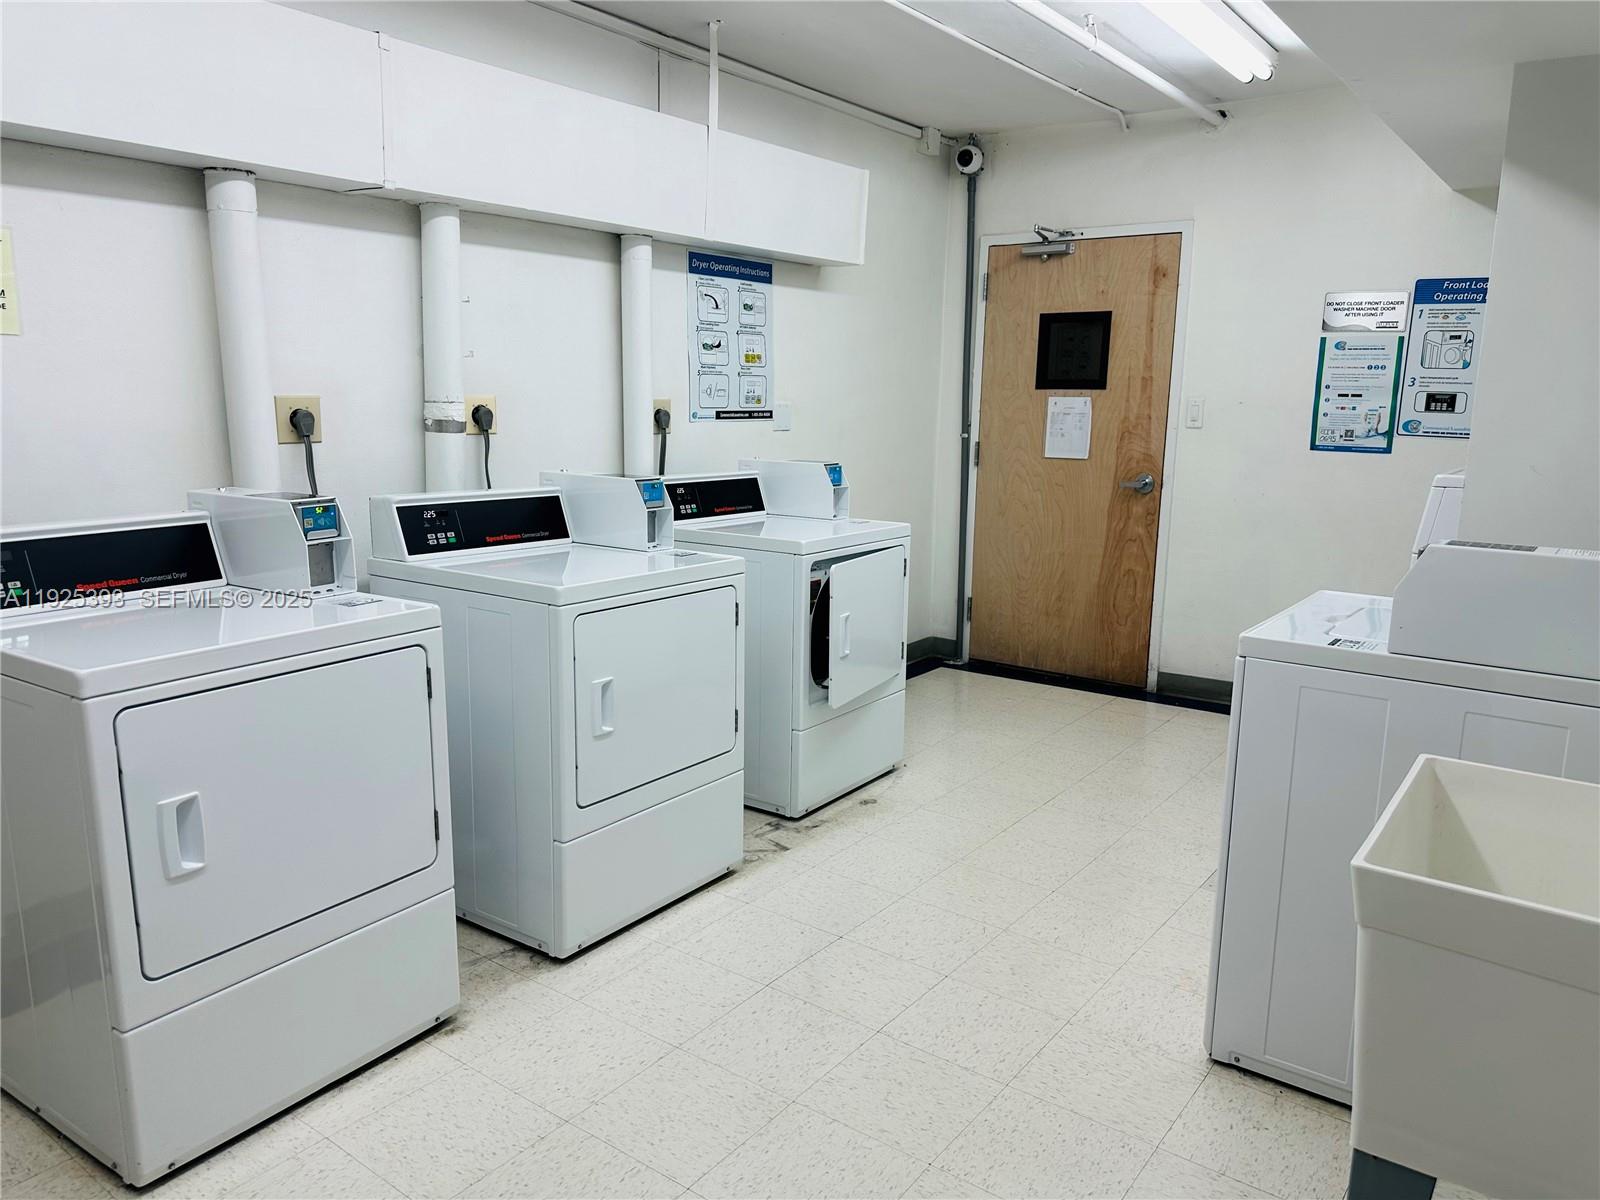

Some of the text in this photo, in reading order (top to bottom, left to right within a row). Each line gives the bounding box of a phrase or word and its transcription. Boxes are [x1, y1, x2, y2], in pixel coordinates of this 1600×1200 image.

[692, 258, 770, 277] Dryer Operating Instructions
[1434, 292, 1484, 302] Operating
[1419, 309, 1424, 319] 1
[1408, 377, 1416, 387] 3
[76, 582, 107, 590] Speed
[108, 578, 139, 587] Queen
[140, 573, 172, 583] Commercial
